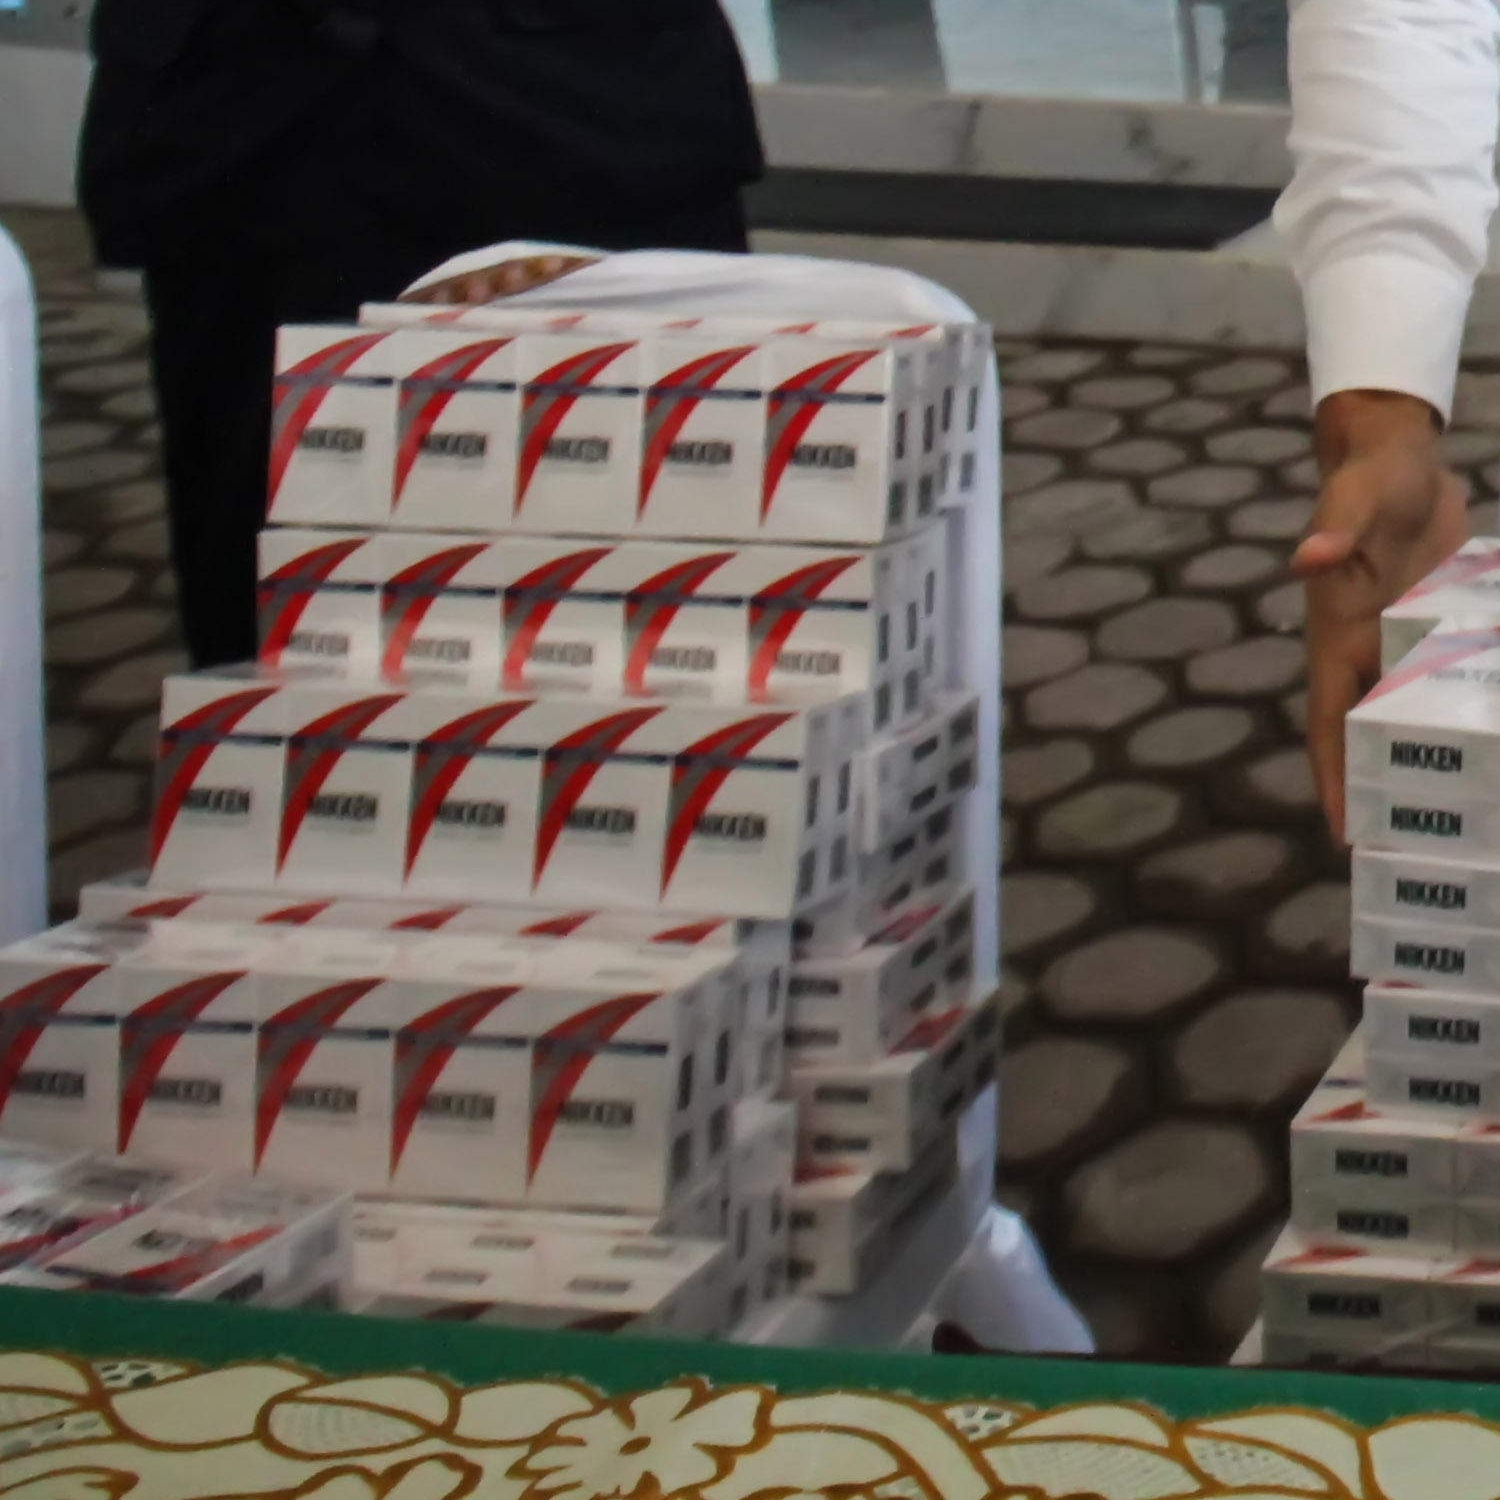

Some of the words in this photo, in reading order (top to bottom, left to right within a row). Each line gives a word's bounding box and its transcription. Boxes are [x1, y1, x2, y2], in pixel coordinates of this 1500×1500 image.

[1390, 741, 1463, 772] NIKKEN
[1390, 806, 1462, 837] NIKKEN
[1396, 878, 1466, 910] NIKKEN
[1395, 942, 1465, 976] NIKKEN
[1408, 1014, 1480, 1045] NIKKEN
